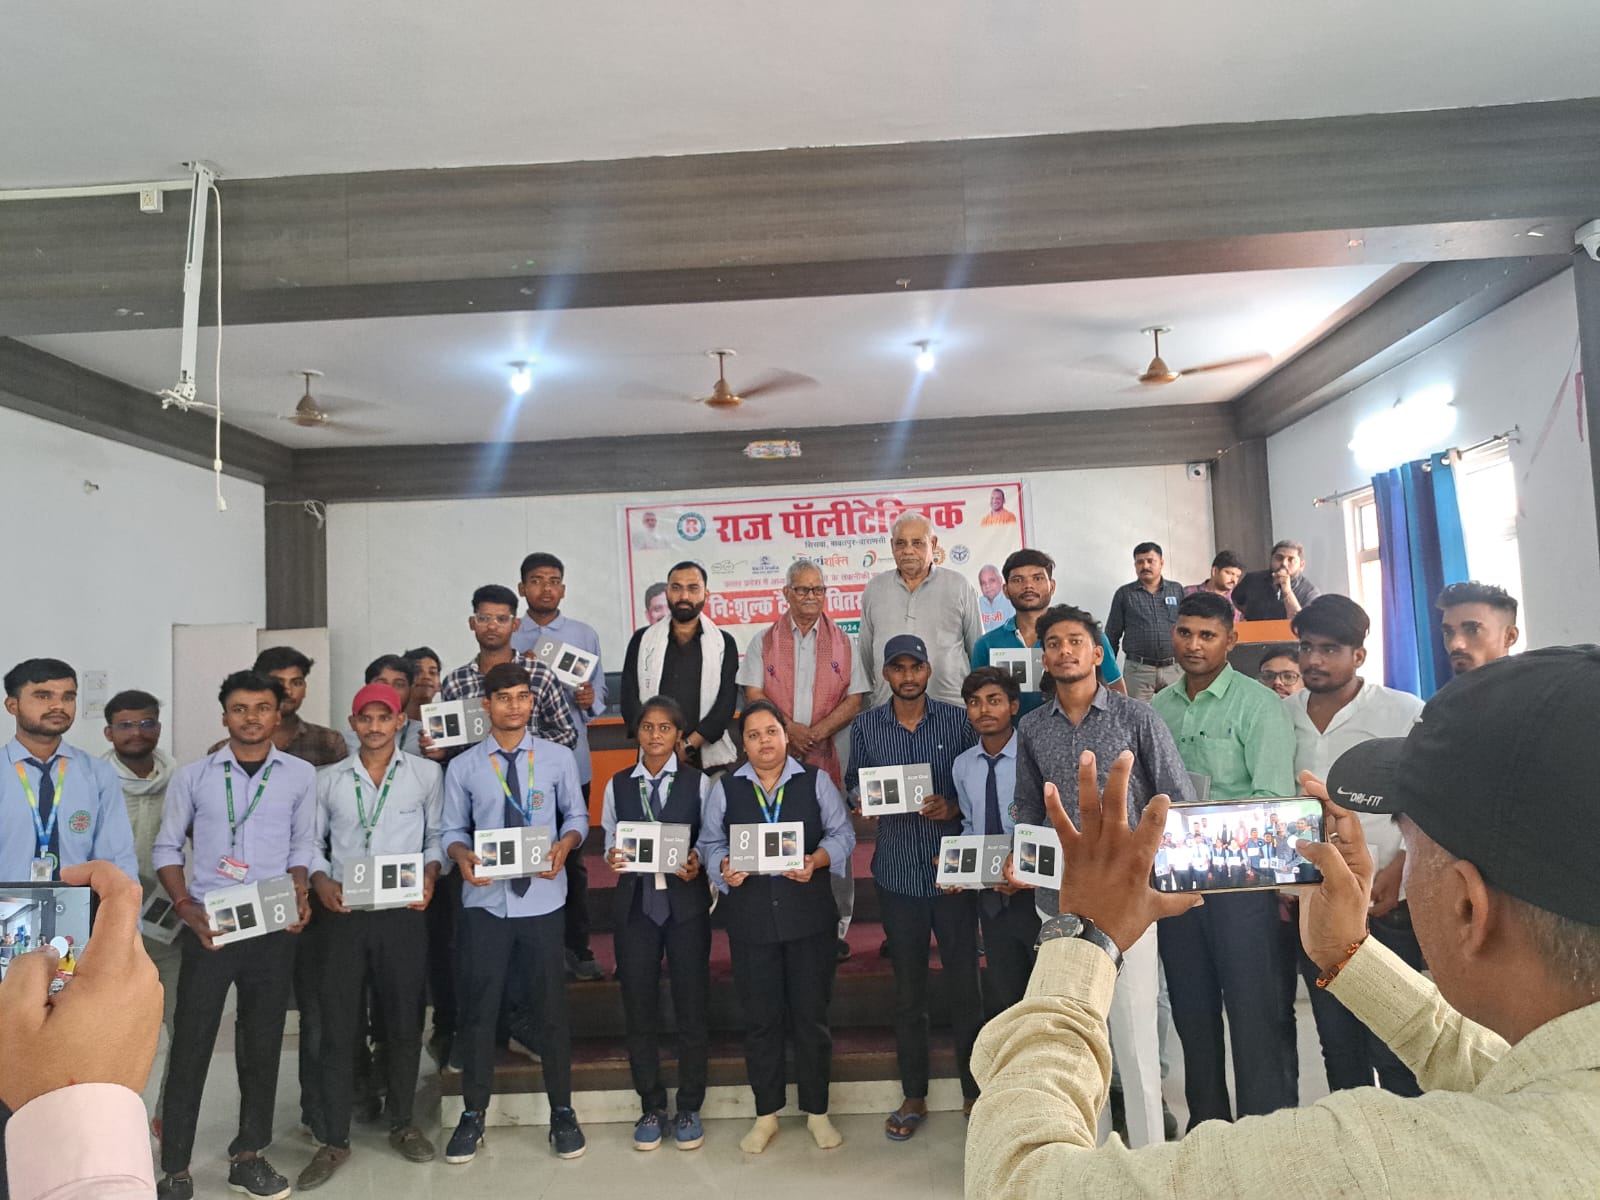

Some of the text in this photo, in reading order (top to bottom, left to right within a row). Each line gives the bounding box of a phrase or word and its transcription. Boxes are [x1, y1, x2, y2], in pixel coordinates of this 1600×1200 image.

[713, 513, 772, 543] राज
[541, 642, 554, 657] 8
[474, 717, 484, 736] 8
[914, 785, 924, 805] 8
[740, 830, 750, 850] 8
[531, 846, 541, 865] 8
[667, 847, 678, 867] 8
[990, 855, 1001, 875] 8
[354, 863, 366, 884] 8
[274, 903, 286, 924] 8
